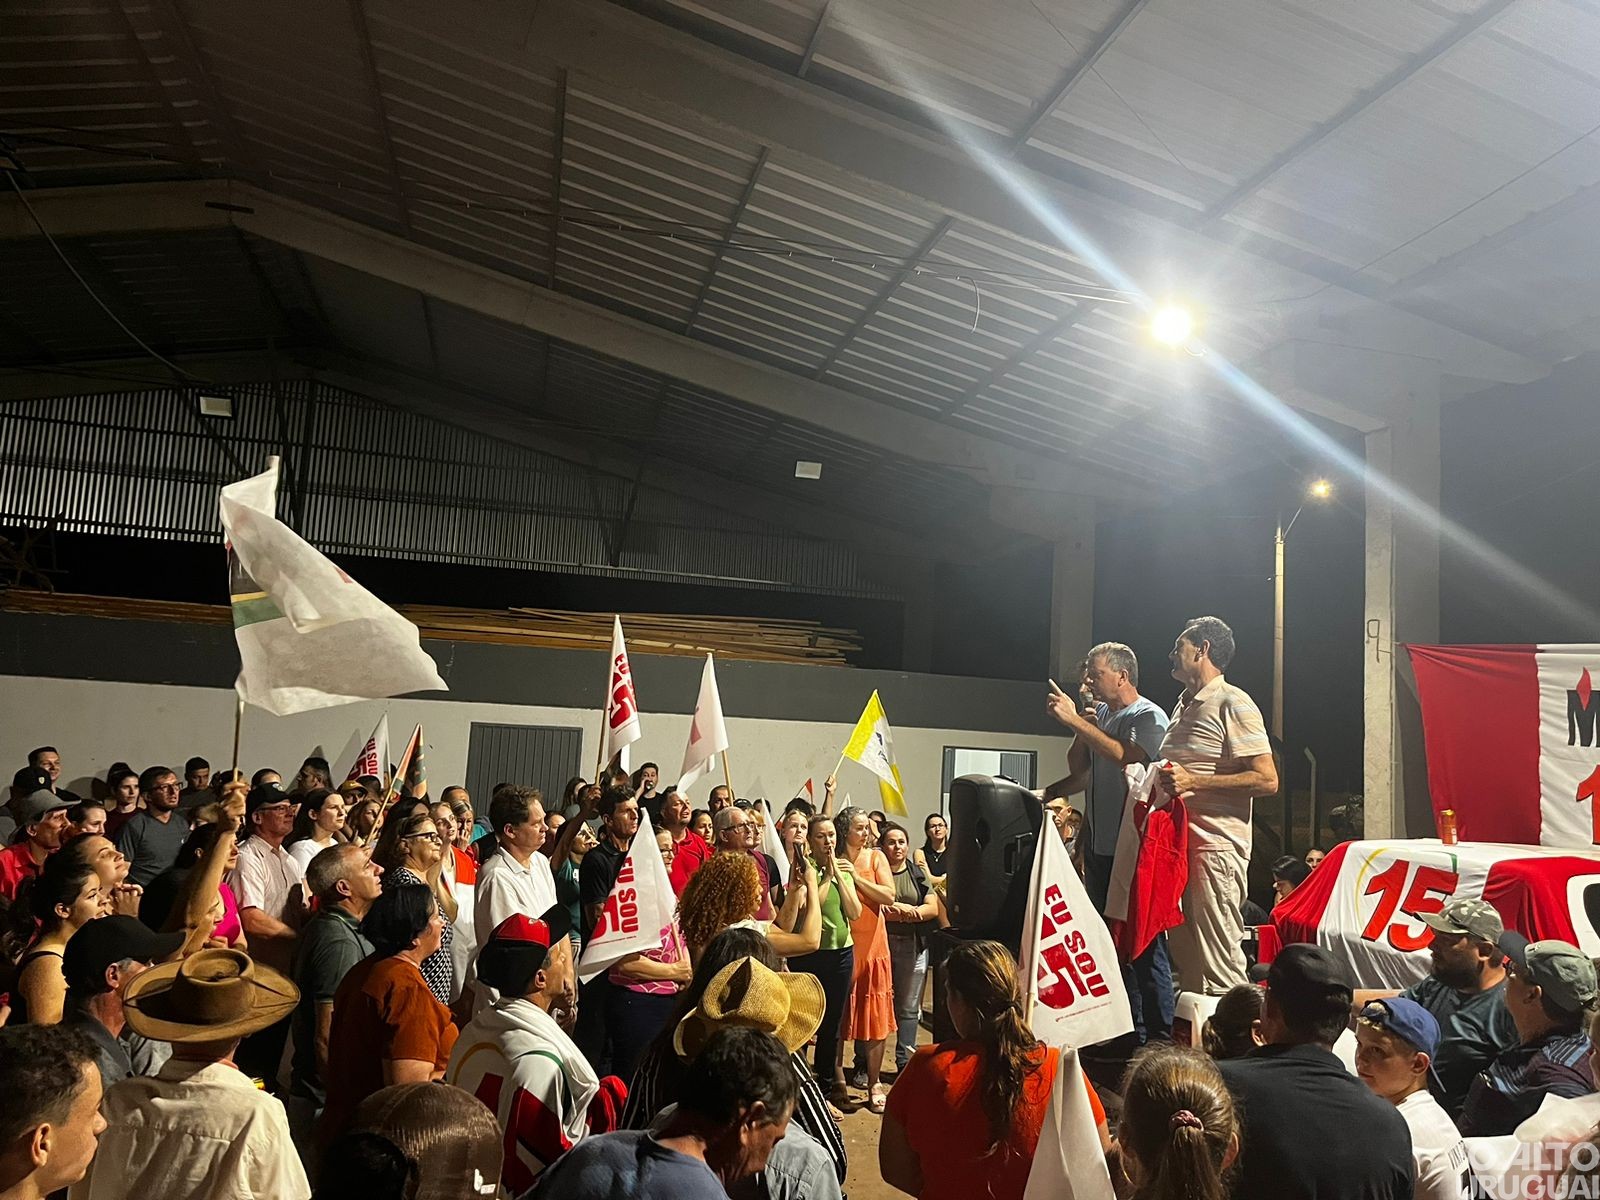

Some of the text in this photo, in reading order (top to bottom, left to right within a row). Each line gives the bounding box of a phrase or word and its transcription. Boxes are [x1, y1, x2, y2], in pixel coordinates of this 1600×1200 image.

[366, 752, 378, 775] SOU
[618, 887, 639, 934] SOU
[1044, 883, 1073, 925] EU
[1064, 930, 1110, 997] SOU
[1361, 859, 1459, 952] 15
